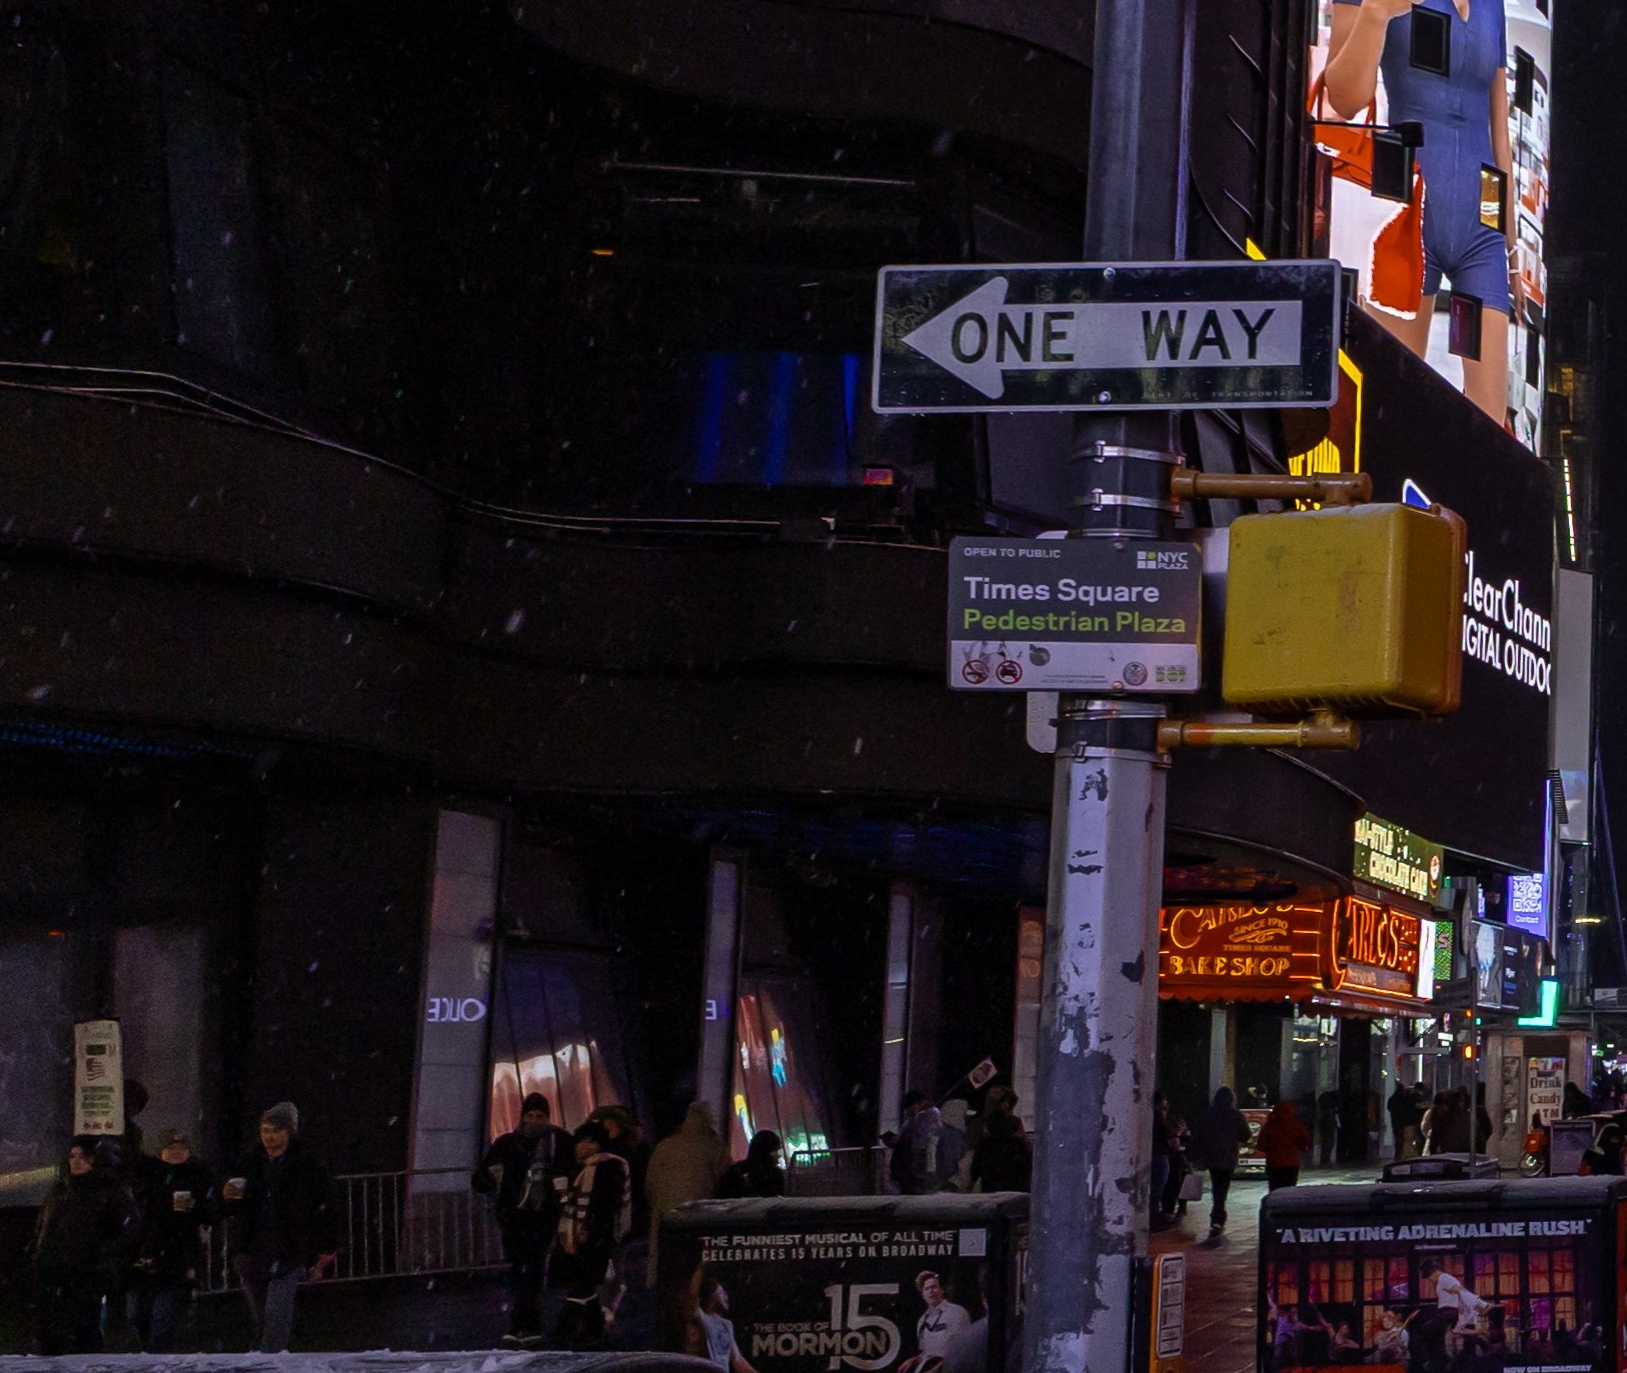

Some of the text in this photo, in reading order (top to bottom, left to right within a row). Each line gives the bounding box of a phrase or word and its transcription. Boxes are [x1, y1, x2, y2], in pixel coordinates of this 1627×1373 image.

[950, 308, 1276, 365] ONE WAY
[963, 547, 1061, 559] OPEN TO PUBLIC
[1157, 551, 1188, 564] NYC
[963, 576, 1160, 606] Times Square
[963, 608, 1186, 633] Pedestrian Plaza
[1462, 615, 1502, 670] IGITAL
[1234, 920, 1266, 935] SINCE
[1169, 955, 1291, 976] BAKE SHOP
[1530, 1077, 1562, 1088] Drink
[1530, 1093, 1561, 1106] Candy
[702, 1230, 954, 1248] THE FUNNIEST MUSICAL OF ALL TIME
[1299, 1225, 1394, 1244] RIVETING
[1398, 1222, 1526, 1241] ADRENALINE
[702, 1243, 954, 1262] CELEBRATES 15 YEARS ON BROADWAY
[754, 1322, 773, 1332] THE
[774, 1322, 811, 1332] BOOK
[823, 1283, 900, 1371] 15
[752, 1331, 888, 1357] MORMON
